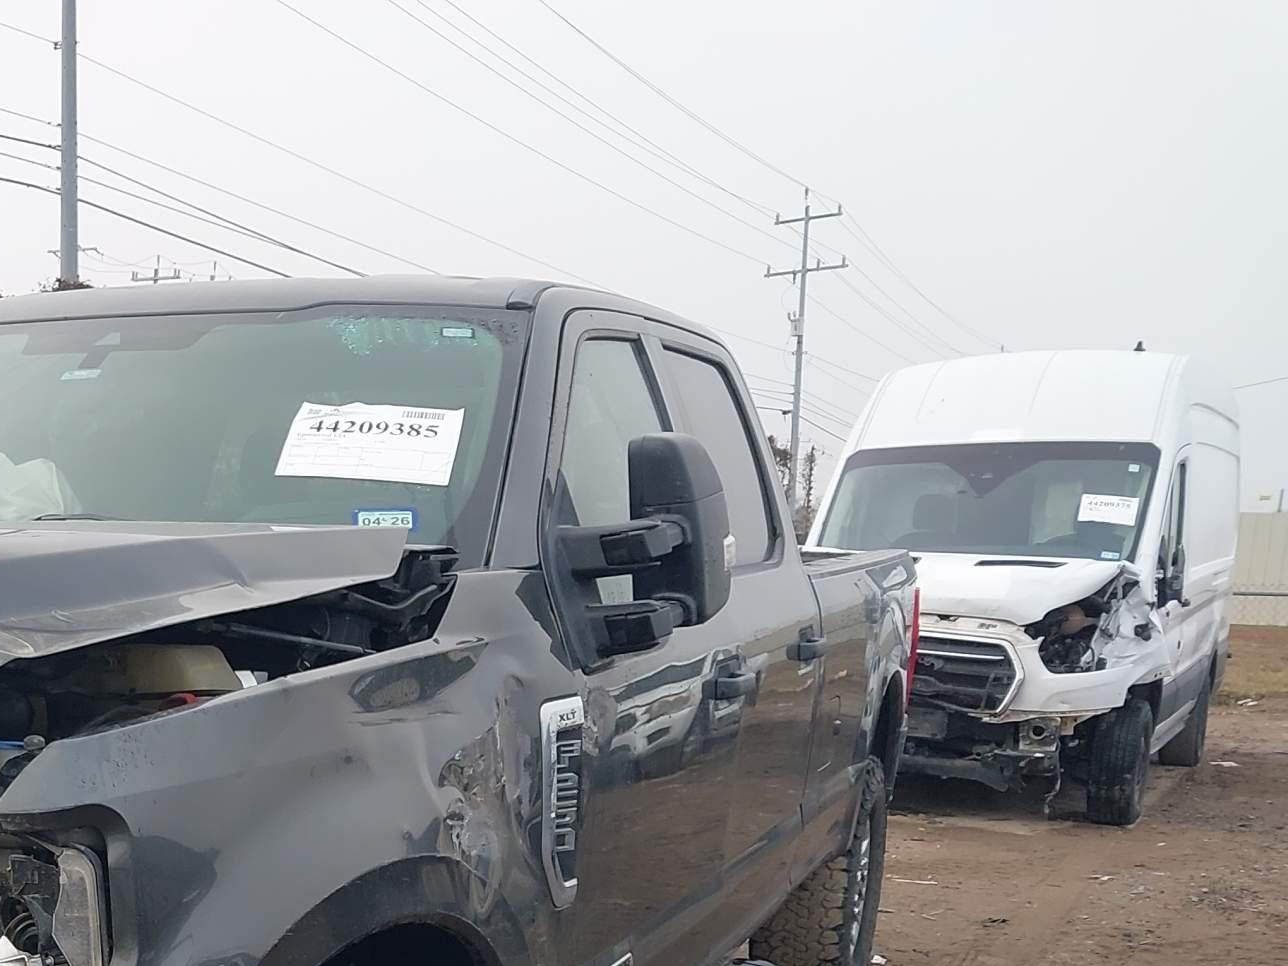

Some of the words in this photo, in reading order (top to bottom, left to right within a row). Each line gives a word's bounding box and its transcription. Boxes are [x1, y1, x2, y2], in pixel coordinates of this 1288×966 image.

[309, 420, 440, 438] 44209385
[362, 517, 381, 526] 04
[391, 516, 410, 526] 26
[558, 710, 577, 722] XLT
